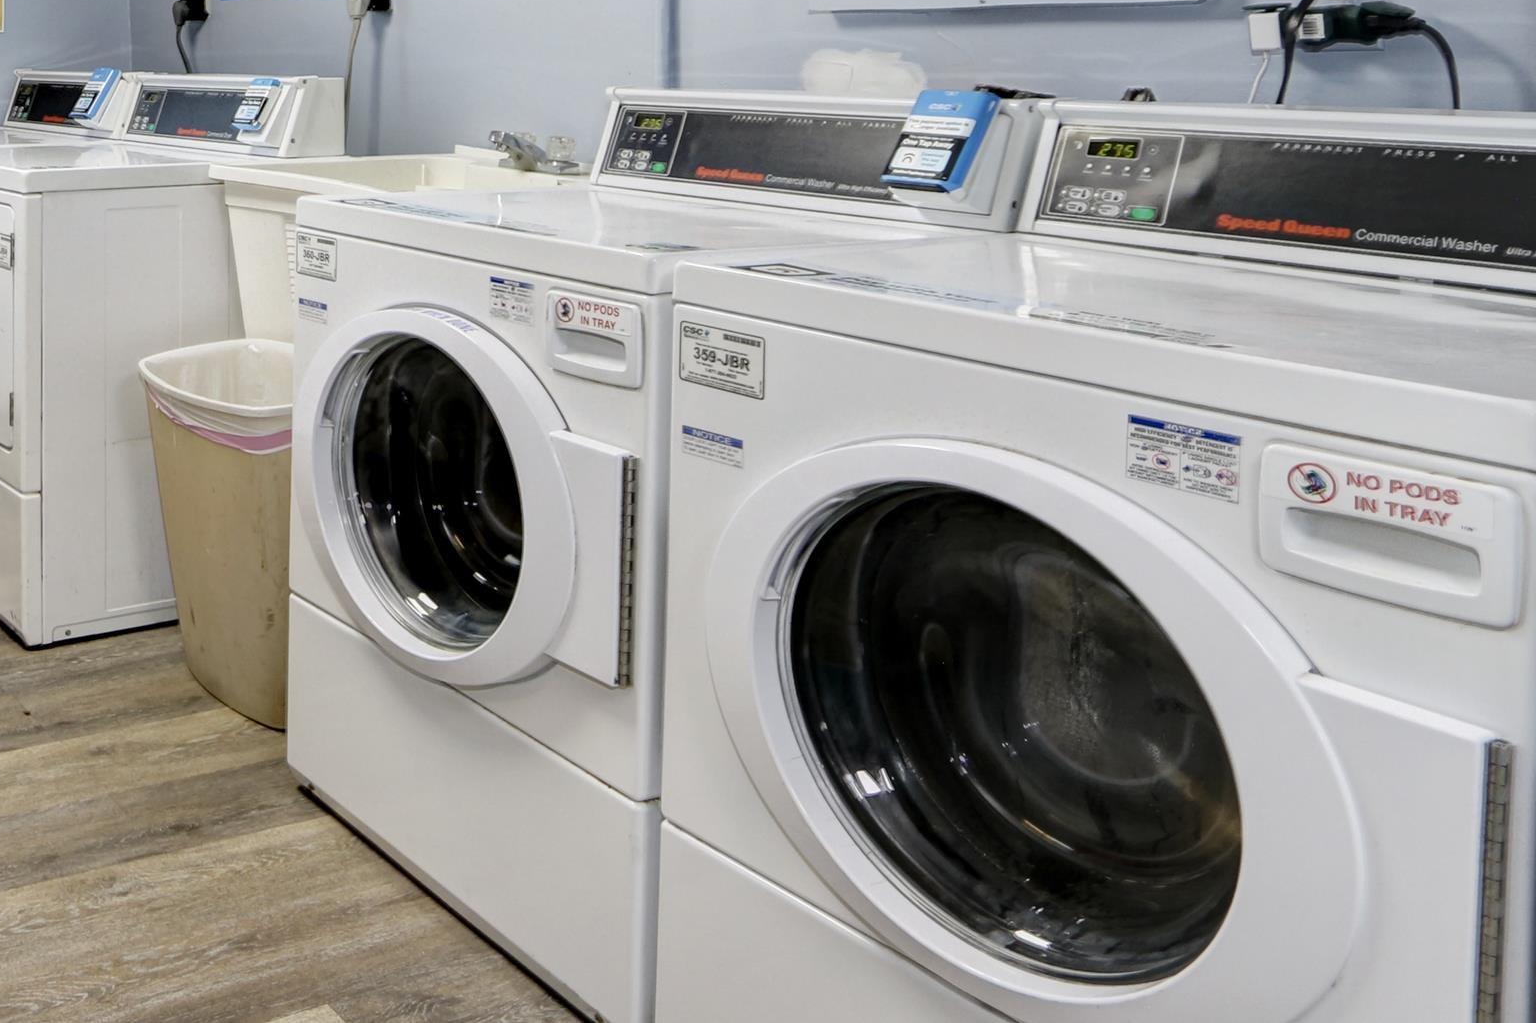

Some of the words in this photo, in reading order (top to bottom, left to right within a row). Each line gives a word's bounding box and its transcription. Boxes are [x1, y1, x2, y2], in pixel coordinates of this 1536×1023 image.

[902, 138, 918, 146] One
[918, 140, 932, 148] Tap
[932, 140, 955, 150] Away
[1098, 142, 1136, 158] 275
[1270, 142, 1364, 154] PERMANENT
[1382, 148, 1436, 157] PRESS
[1484, 154, 1519, 163] ALL
[695, 166, 729, 180] Speed
[765, 174, 806, 186] Commercial
[807, 176, 835, 189] Washer
[1216, 214, 1282, 232] Speed
[1282, 219, 1351, 239] Queen
[1355, 228, 1438, 248] Commercial
[1441, 236, 1499, 254] Washer
[577, 301, 591, 312] NO
[593, 304, 620, 317] PODS
[580, 316, 589, 325] IN
[592, 318, 616, 330] TRAY
[683, 326, 704, 336] CSC
[693, 347, 750, 371] 359-JBR
[693, 429, 728, 444] NOTICE
[1346, 471, 1381, 490] NO
[1389, 479, 1460, 505] PODS
[1354, 495, 1378, 513] IN
[1384, 500, 1452, 527] TRAY
